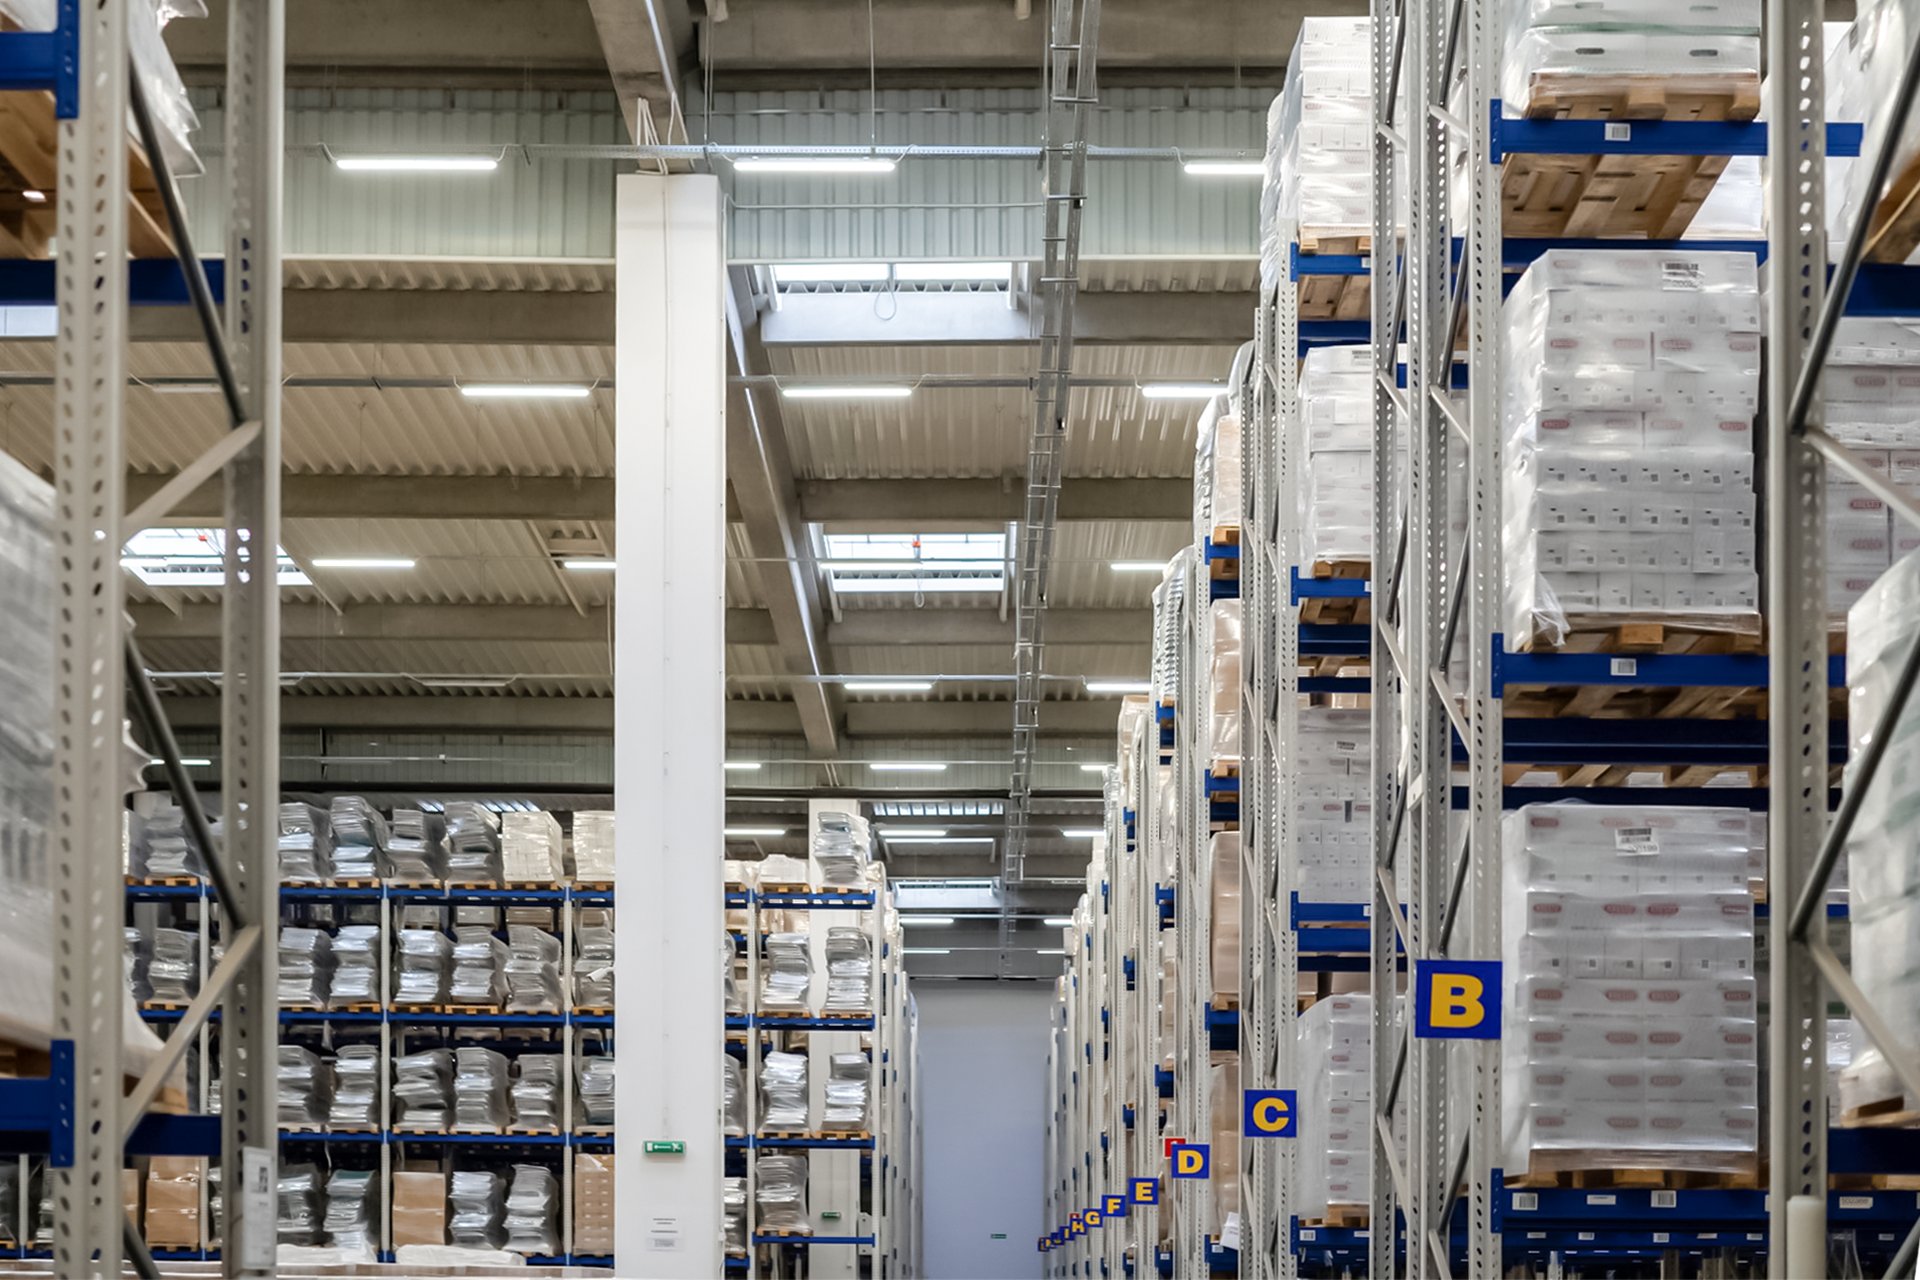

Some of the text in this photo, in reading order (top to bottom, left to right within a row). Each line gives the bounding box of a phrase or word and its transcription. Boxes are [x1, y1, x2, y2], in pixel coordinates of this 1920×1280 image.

[1430, 973, 1485, 1028] B
[1252, 1097, 1289, 1132] C
[1177, 1149, 1204, 1174] D
[1135, 1182, 1153, 1201] E
[1107, 1198, 1121, 1214] F
[1072, 1221, 1085, 1232] H
[1085, 1211, 1100, 1225] G
